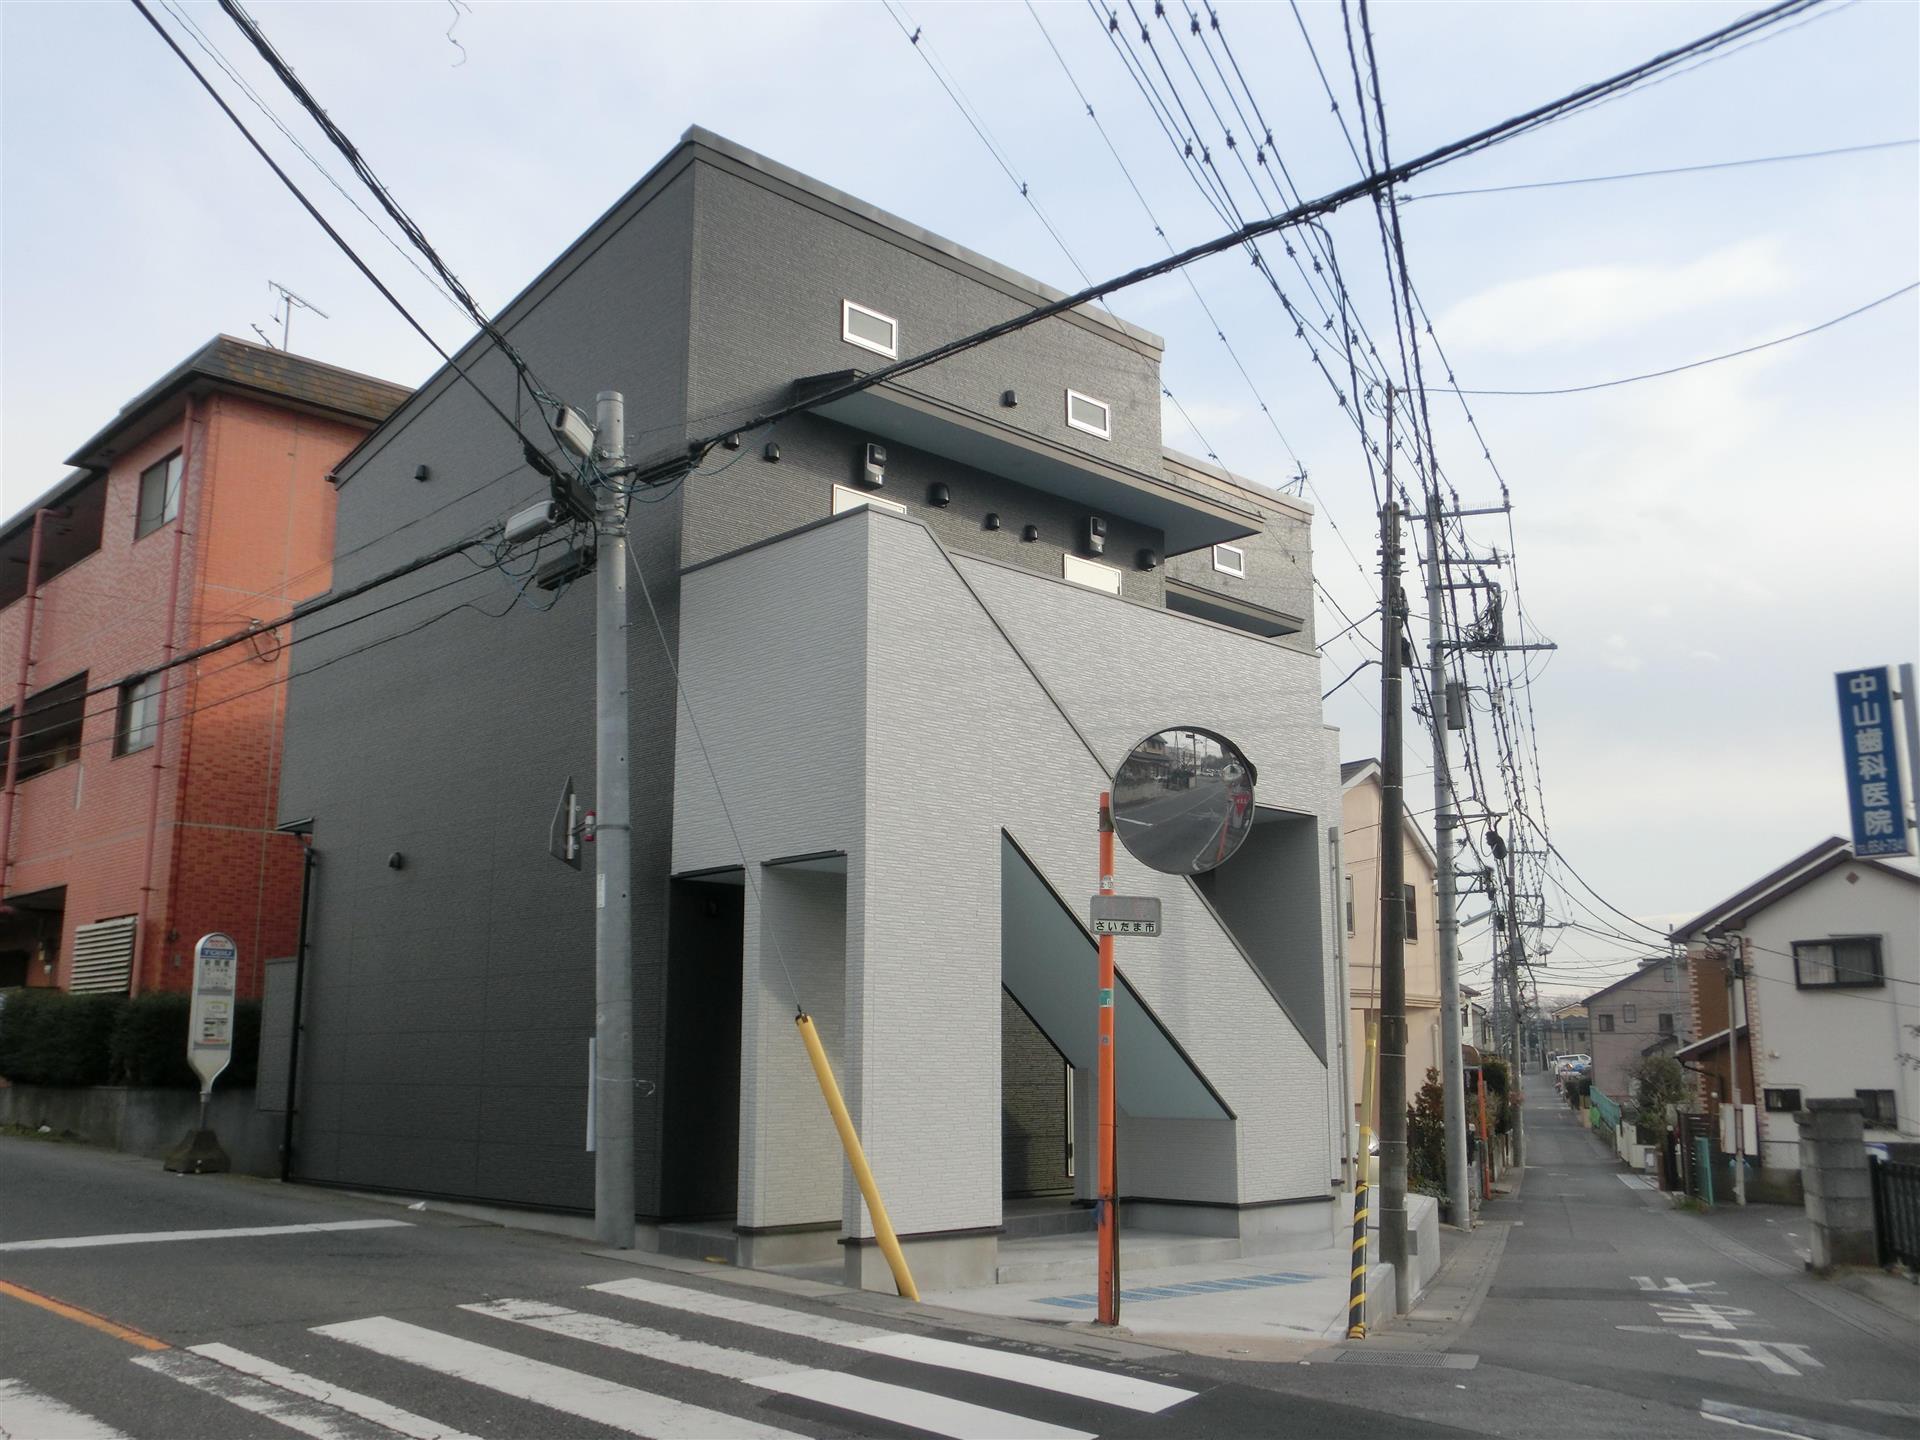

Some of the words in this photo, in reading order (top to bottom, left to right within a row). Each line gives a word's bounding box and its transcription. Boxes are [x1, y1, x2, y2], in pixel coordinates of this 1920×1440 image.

[1849, 673, 1893, 836] 中山歯科医院
[1095, 921, 1156, 933] さいたま市
